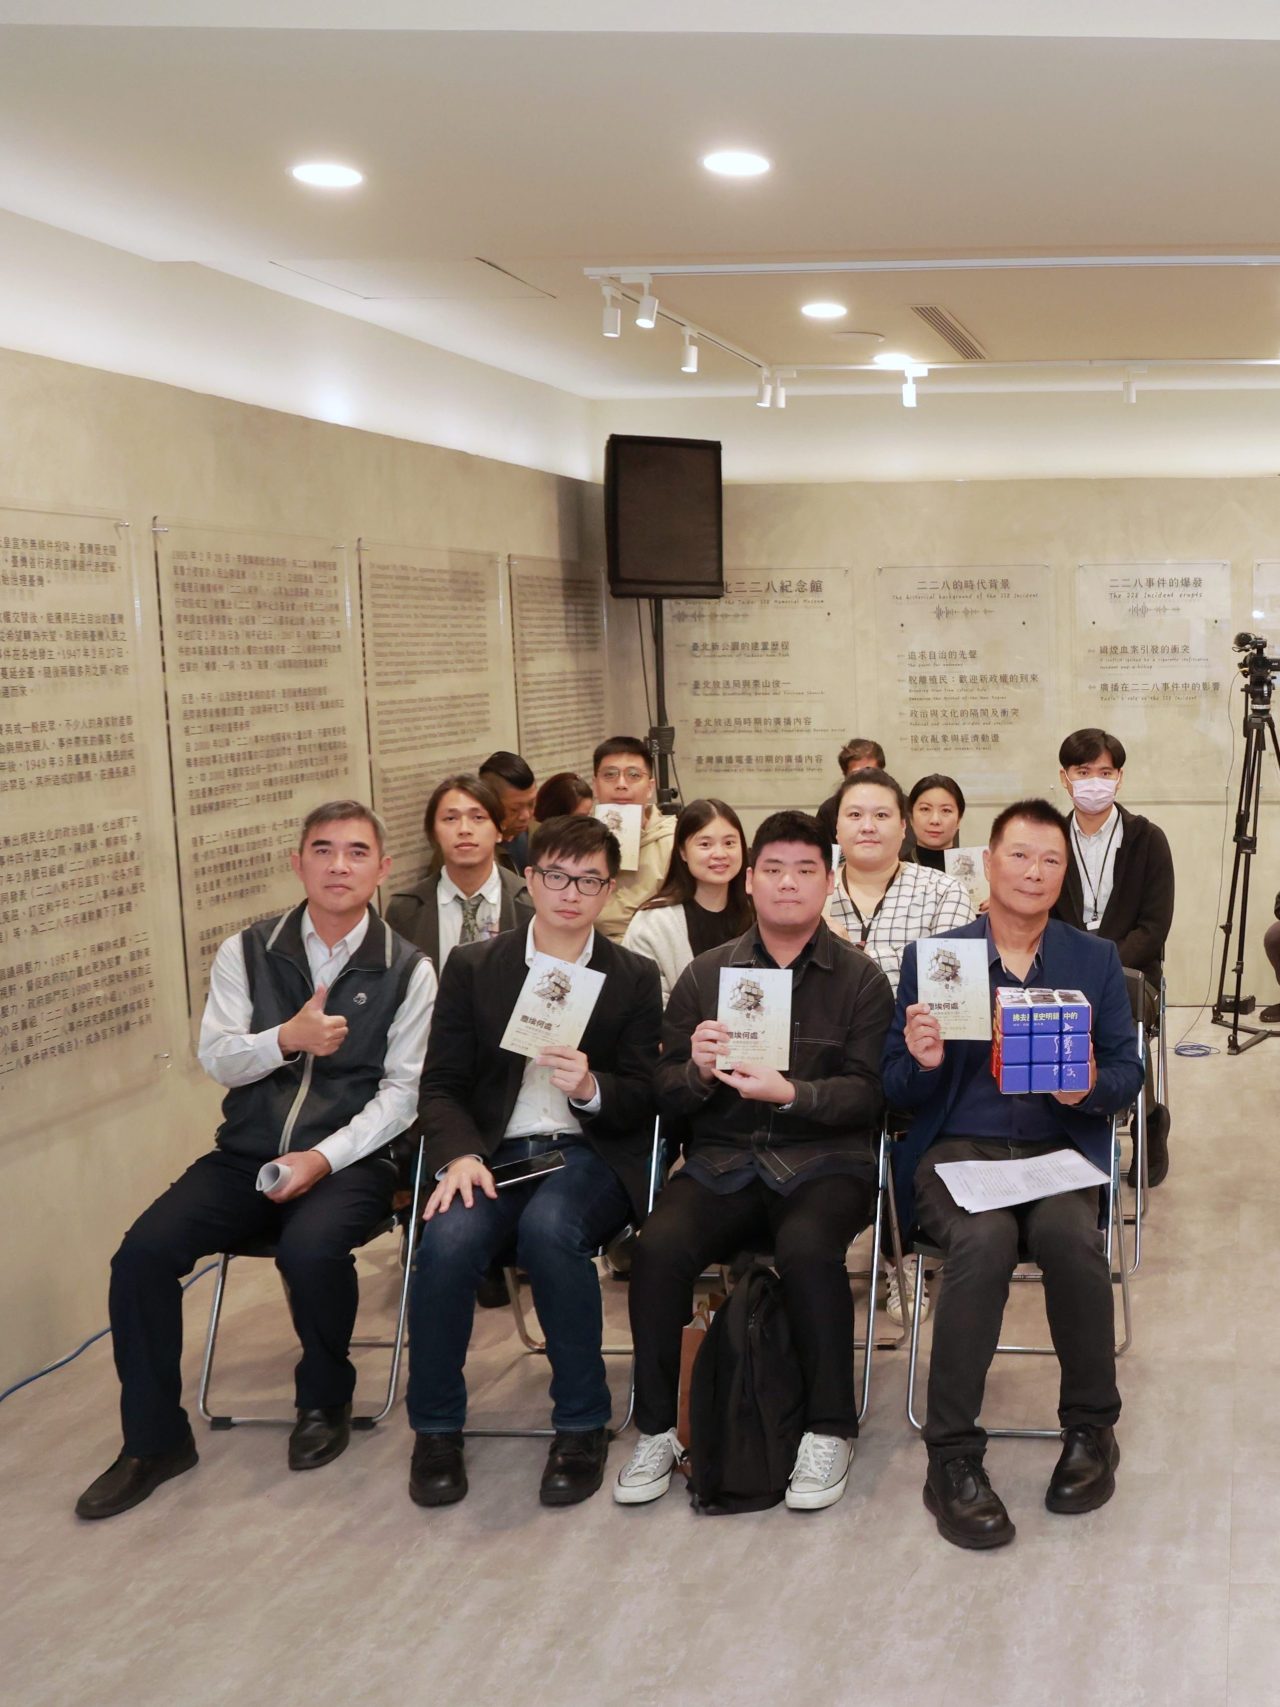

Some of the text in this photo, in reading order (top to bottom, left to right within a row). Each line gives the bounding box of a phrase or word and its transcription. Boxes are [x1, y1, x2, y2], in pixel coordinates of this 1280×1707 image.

[917, 579, 1010, 590] 二二八的時代背景
[1109, 578, 1203, 588] 二二八事件的爆發
[908, 650, 977, 660] 追求自治的先聲
[1100, 645, 1190, 655] 緝煙血案引發的衝突
[909, 674, 1039, 685] 脫離殖民：歡迎新政權的到來
[1101, 682, 1220, 692] 廣播在二二八事件中的影響
